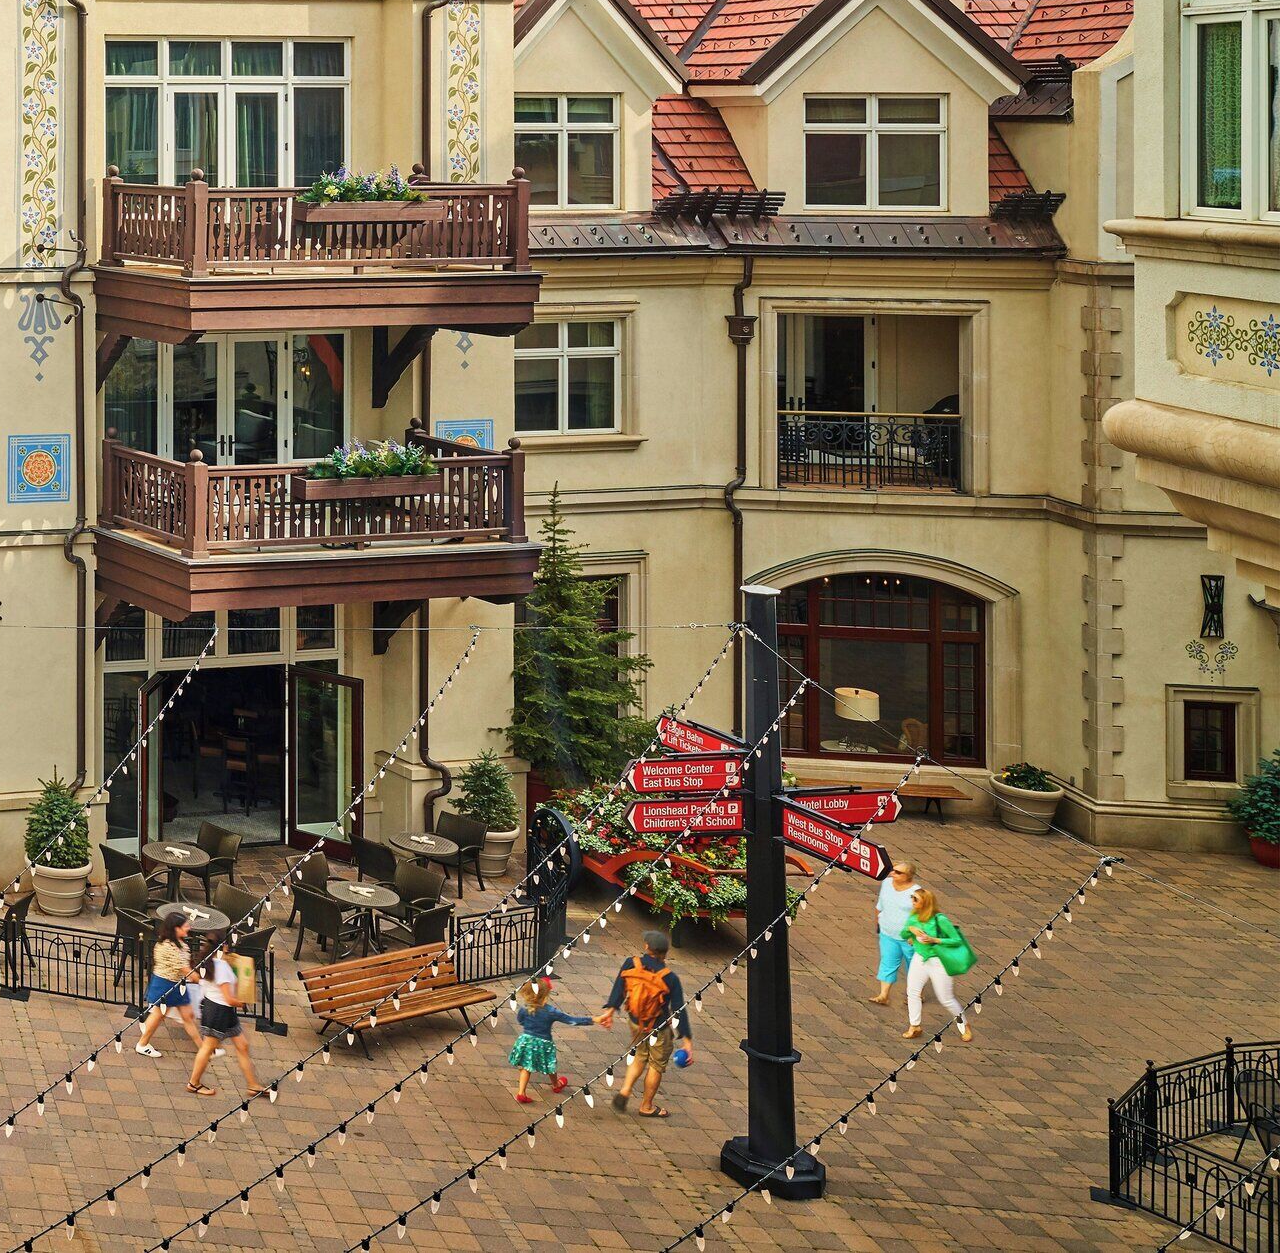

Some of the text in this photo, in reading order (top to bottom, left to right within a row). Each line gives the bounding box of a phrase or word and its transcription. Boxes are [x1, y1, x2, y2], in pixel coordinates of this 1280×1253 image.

[667, 722, 704, 746] Eagle Bahn
[667, 733, 678, 746] Lift
[642, 764, 714, 776] Welcome Center
[643, 776, 704, 788] East Bus Stop
[643, 804, 724, 817] Lionshead Parking
[824, 799, 849, 810] Lobby
[643, 817, 686, 828] Children's
[706, 816, 736, 826] School
[787, 813, 843, 848] West Bus Stop
[787, 825, 829, 853] Restrooms
